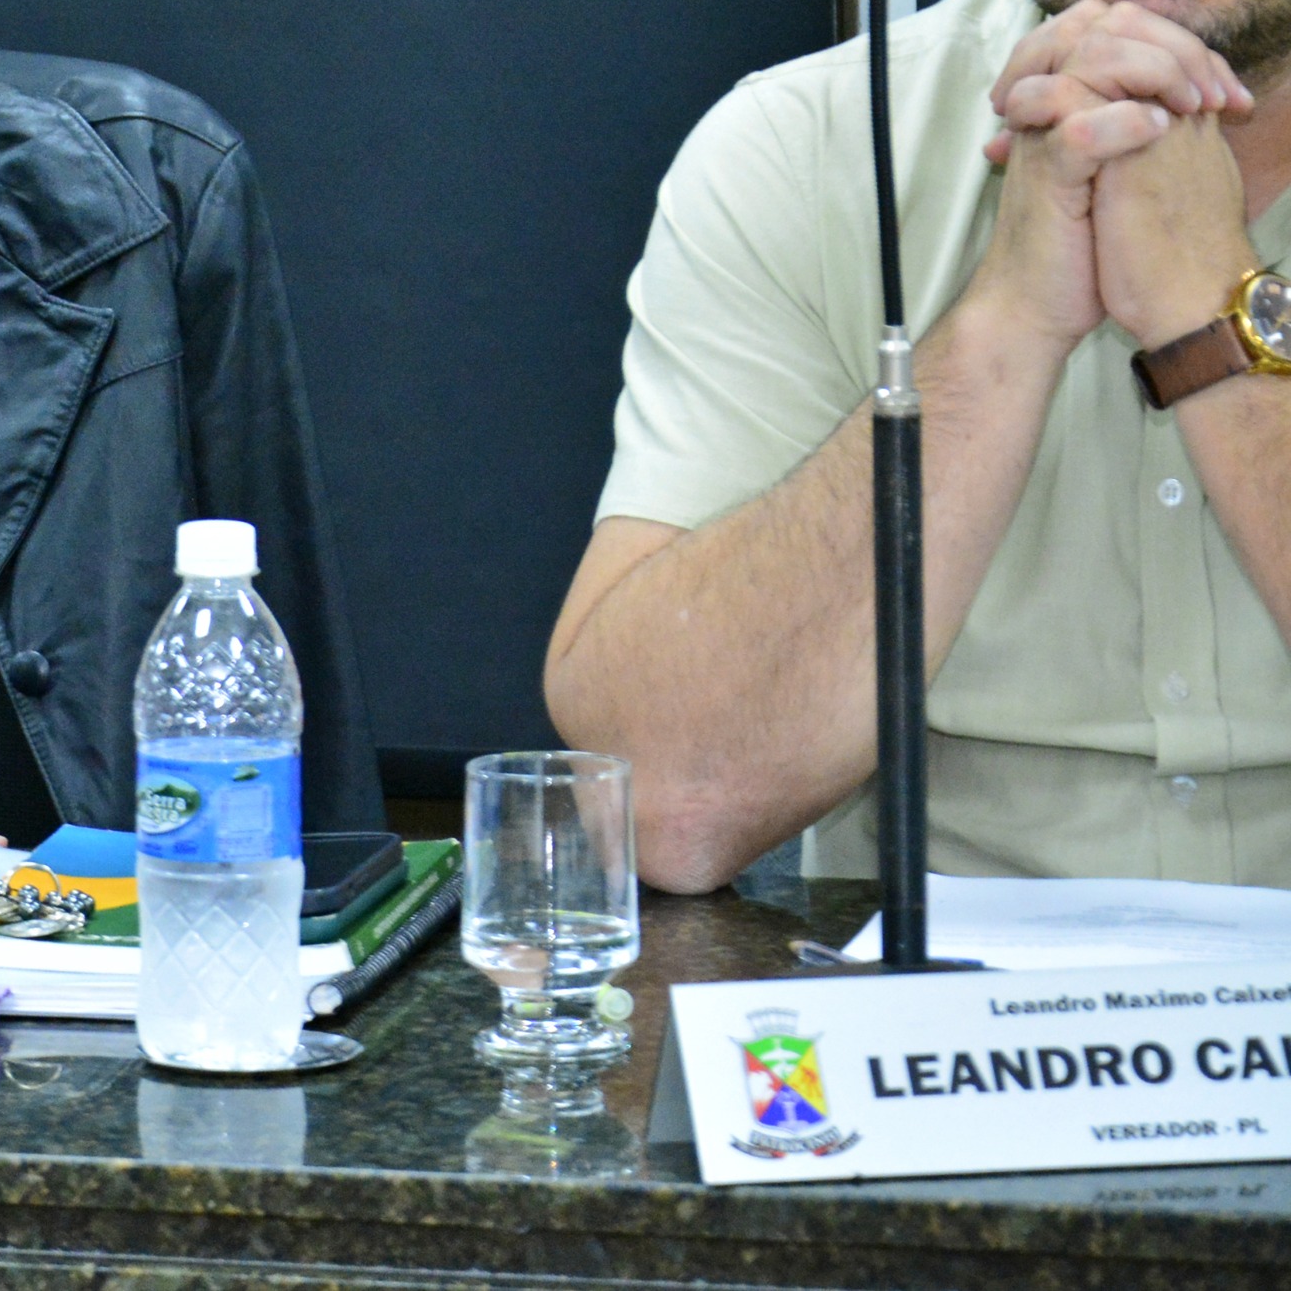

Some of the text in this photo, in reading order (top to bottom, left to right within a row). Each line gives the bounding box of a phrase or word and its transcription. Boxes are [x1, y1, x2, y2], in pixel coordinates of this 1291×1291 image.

[990, 996, 1097, 1016] Leandro
[1104, 991, 1207, 1010] Maximo
[868, 1035, 1291, 1099] LEANDRO CA
[1091, 1120, 1218, 1142] VEREADOR
[1237, 1117, 1267, 1134] PL
